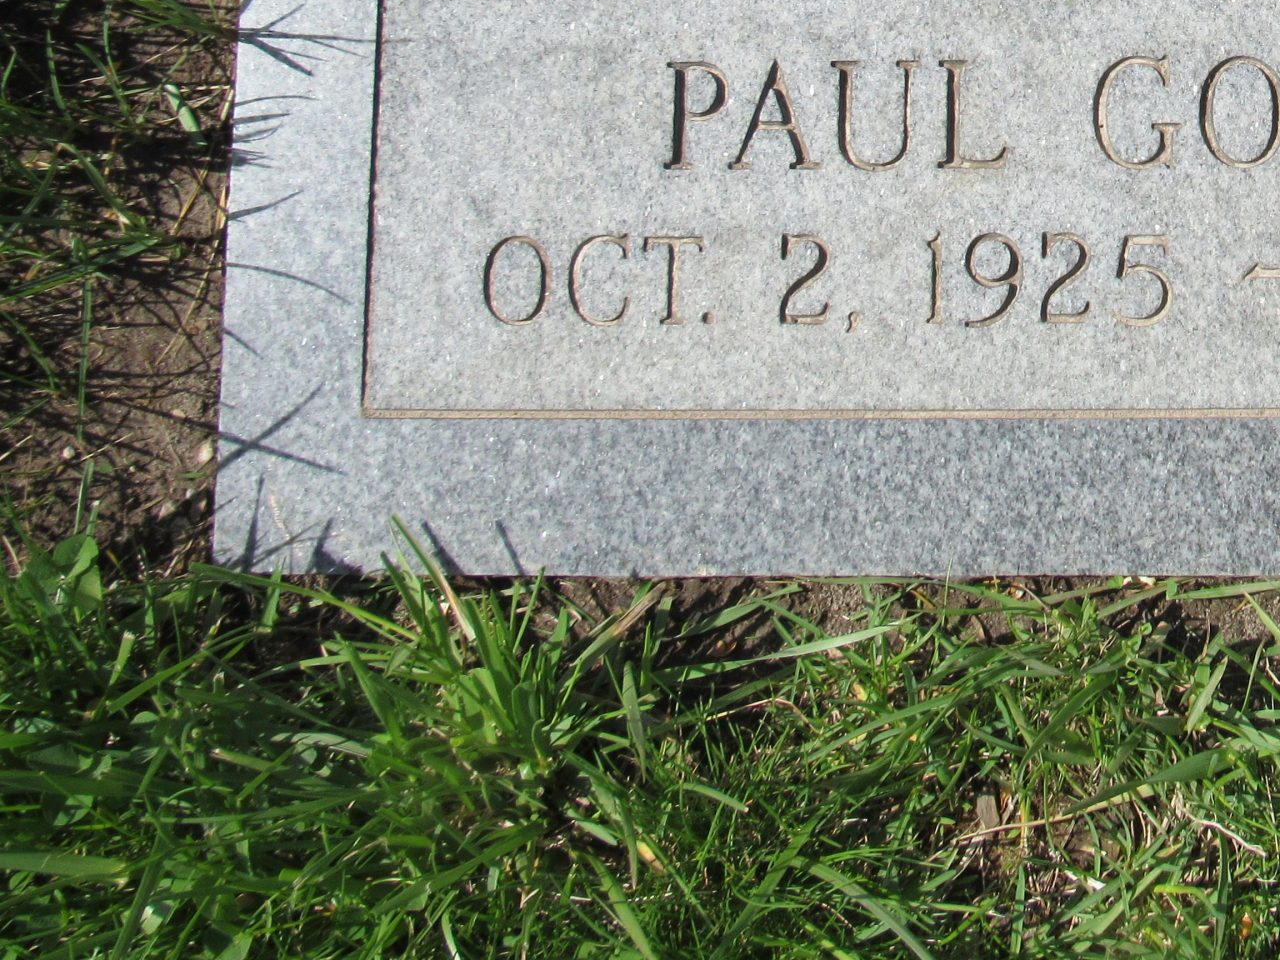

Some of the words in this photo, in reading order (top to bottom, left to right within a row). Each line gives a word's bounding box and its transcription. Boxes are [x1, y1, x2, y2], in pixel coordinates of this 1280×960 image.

[663, 58, 1010, 172] PAUL
[483, 233, 715, 327] OCT.
[779, 232, 862, 333] 2,
[925, 230, 1174, 329] 1925
